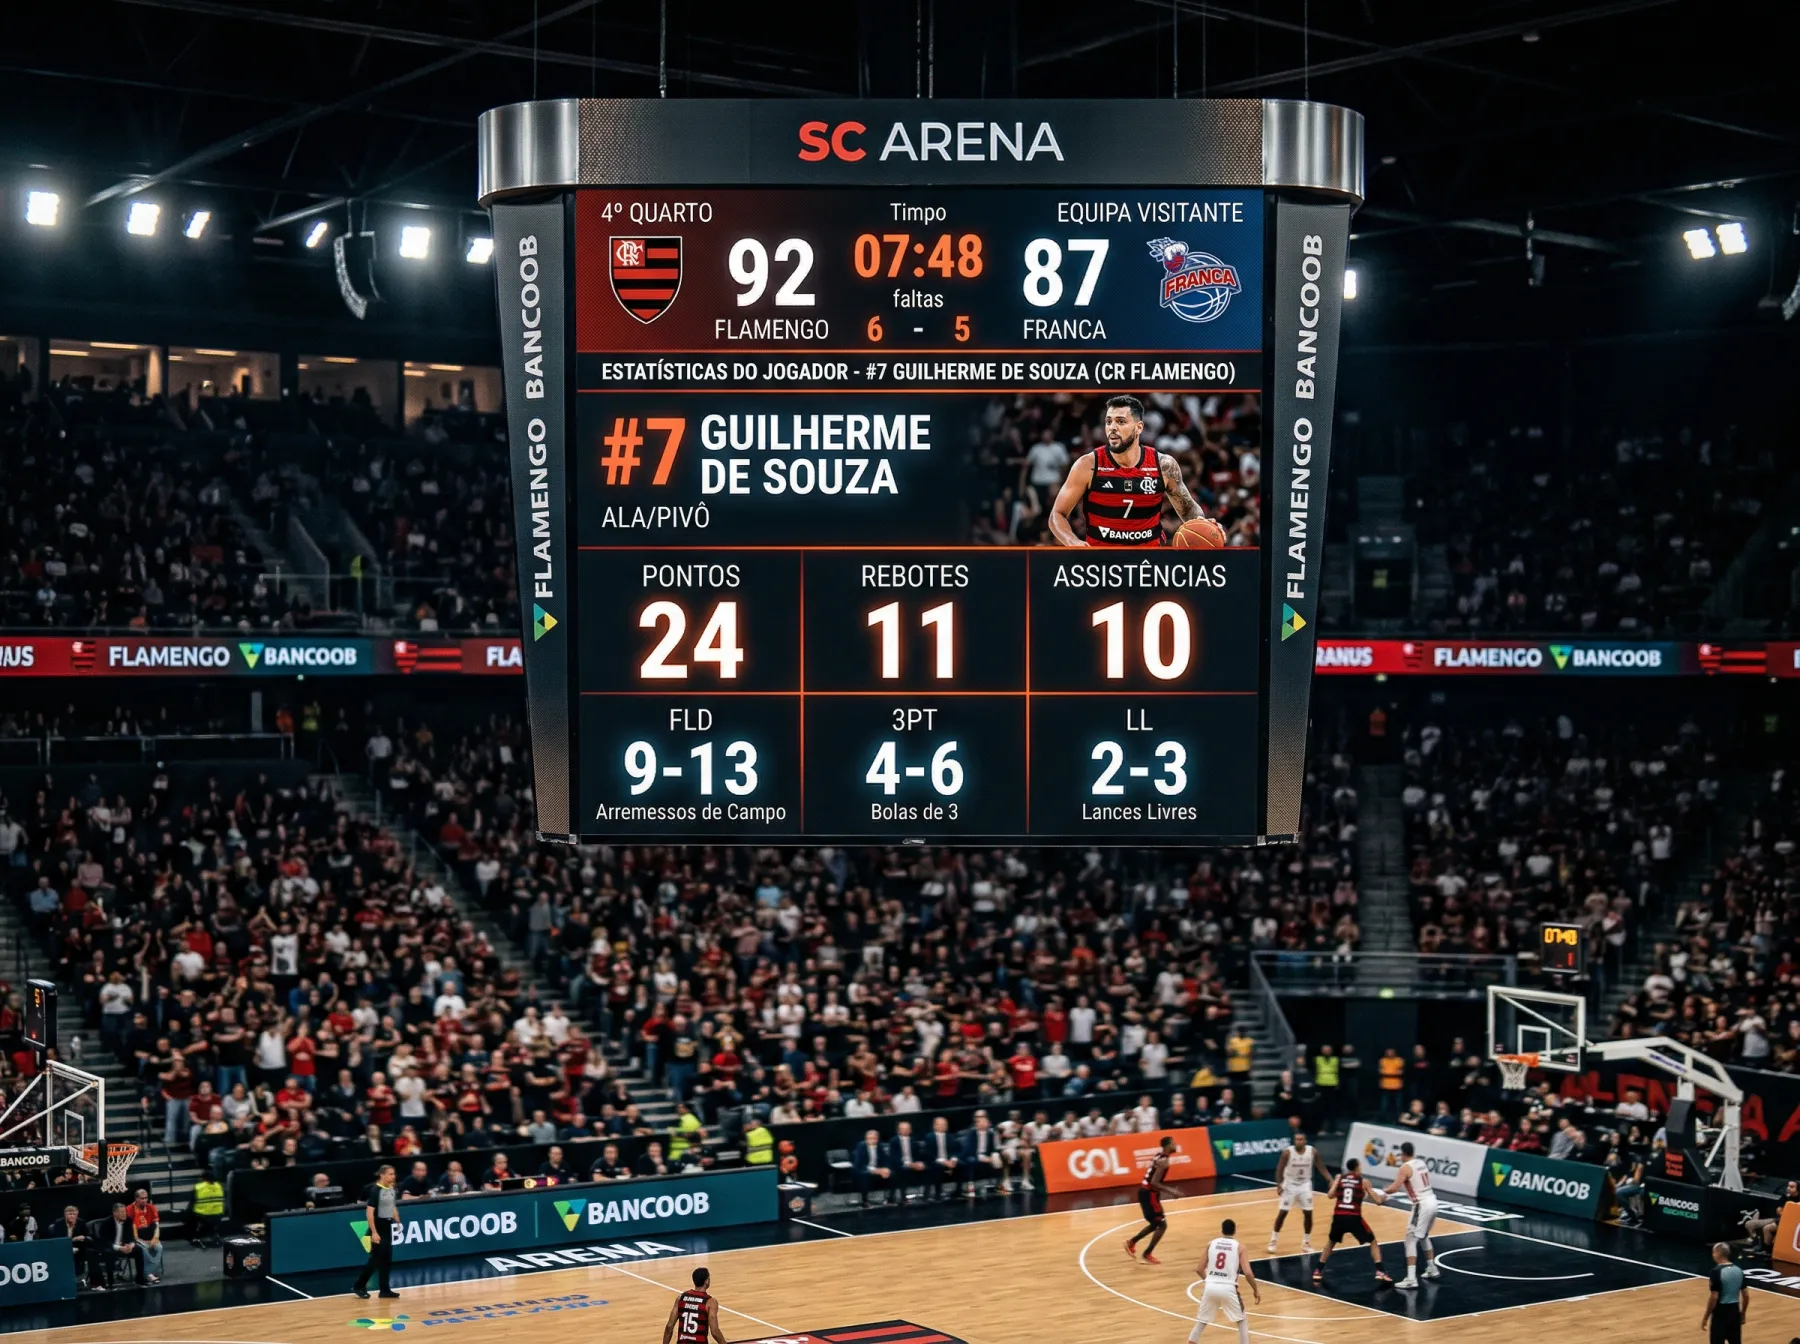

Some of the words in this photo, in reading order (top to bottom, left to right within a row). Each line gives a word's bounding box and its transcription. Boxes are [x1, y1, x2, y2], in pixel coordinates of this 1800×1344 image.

[798, 121, 867, 162] SC
[879, 122, 1065, 162] ARENA
[601, 202, 623, 222] 4º
[629, 202, 713, 226] QUARTO
[889, 202, 947, 226] Timpo
[1058, 202, 1132, 225] EQUIPA
[1137, 202, 1244, 223] VISITANTE
[854, 233, 983, 278] 07:48
[728, 237, 816, 307] 92
[1022, 237, 1110, 307] 87
[1165, 268, 1236, 300] FRANCA
[893, 288, 944, 308] faltas
[519, 235, 545, 399] BANCOOB
[715, 318, 829, 340] FLAMENGO
[867, 315, 883, 342] 6
[954, 315, 970, 342] 5
[1023, 319, 1107, 340] FRANCA
[1295, 234, 1323, 400] BANCOOB
[602, 358, 728, 381] ESTATÍSTICAS
[733, 362, 758, 380] DO
[762, 362, 849, 380] JOGADOR
[865, 362, 888, 380] #7
[893, 362, 997, 380] GUILHERME
[1001, 362, 1024, 380] DE
[1028, 362, 1090, 381] SOUZA
[1094, 361, 1126, 385] (CR
[1130, 361, 1236, 385] FLAMENGO)
[701, 414, 931, 451] GUILHERME
[601, 417, 686, 485] #7
[701, 458, 751, 495] DE
[762, 458, 899, 495] SOUZA
[527, 418, 553, 598] FLAMENGO
[601, 501, 710, 530] ALA/PIVÔ
[1122, 499, 1134, 519] 7
[1286, 417, 1313, 599] FLAMENGO
[1109, 529, 1153, 540] BANCOOB
[643, 564, 740, 588] PONTOS
[862, 564, 969, 588] REBOTES
[1053, 559, 1226, 588] ASSISTÊNCIAS
[638, 600, 744, 679] 24
[867, 601, 954, 679] 11
[1092, 600, 1191, 680] 10
[109, 645, 230, 667] FLAMENGO
[264, 647, 357, 666] BANCOOB
[1434, 647, 1543, 667] FLAMENGO
[1572, 650, 1661, 667] BANCOOB
[670, 708, 713, 731] FLD
[892, 708, 938, 731] 3PT
[1127, 708, 1154, 731] LL
[624, 740, 758, 796] 9-13
[865, 740, 964, 796] 4-6
[1091, 740, 1188, 796] 2-3
[595, 803, 695, 820] Arremessos
[700, 802, 722, 820] de
[727, 803, 786, 825] Campo
[871, 802, 916, 820] Bolas
[923, 802, 944, 820] de
[948, 803, 958, 820] 3
[1082, 803, 1141, 820] Lances
[1147, 803, 1197, 820] Livres
[0, 1155, 50, 1167] BANCOOB
[1068, 1147, 1130, 1179] GOL
[1509, 1169, 1591, 1200] BANCOOB
[588, 1192, 710, 1225] BANCOOB
[391, 1211, 518, 1245] BANCOOB
[485, 1240, 687, 1272] ARENA
[1215, 1252, 1227, 1270] 8
[681, 1311, 699, 1334] 15
